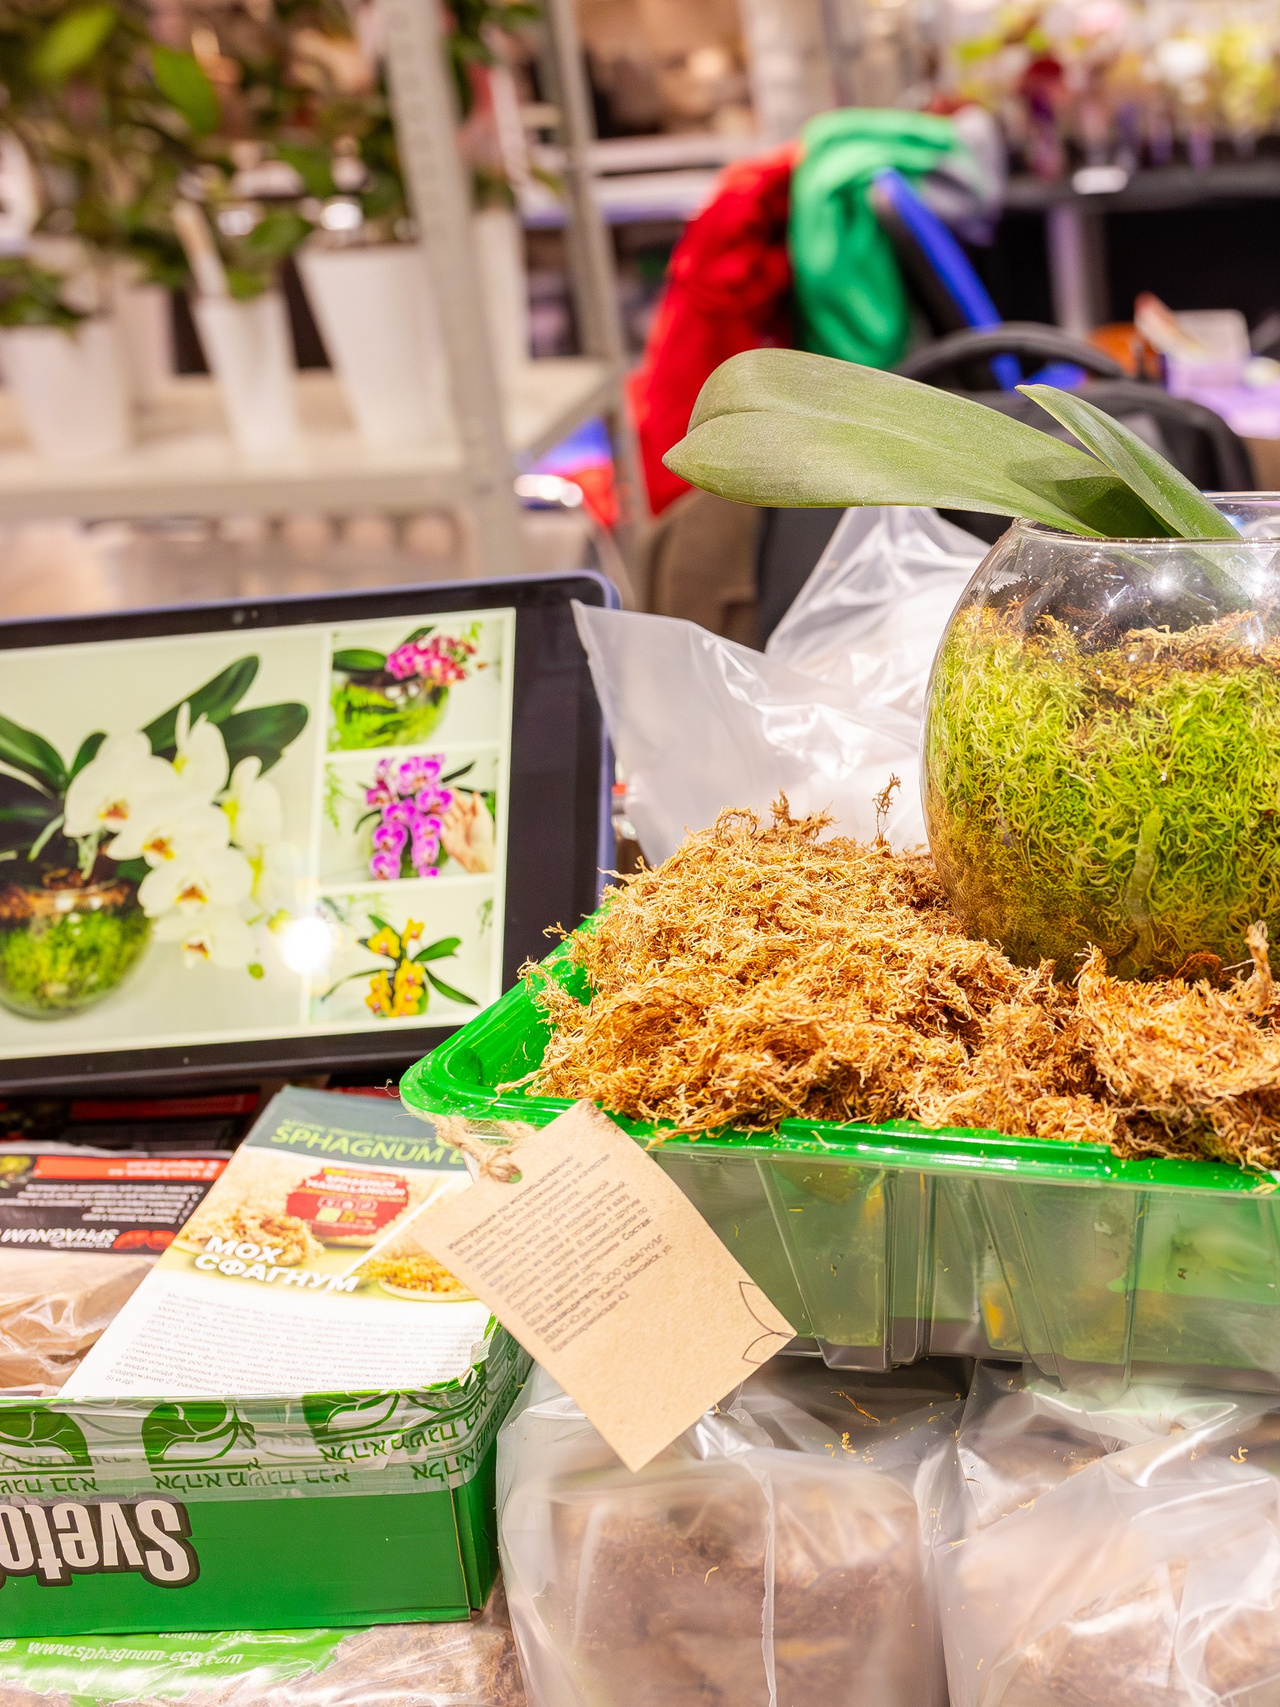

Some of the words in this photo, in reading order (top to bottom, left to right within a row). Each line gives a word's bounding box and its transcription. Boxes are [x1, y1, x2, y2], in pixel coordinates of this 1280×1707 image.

[270, 1126, 444, 1164] SPHAGNUM
[204, 1236, 285, 1265] МОХ
[194, 1253, 361, 1293] СФАГНУМ
[599, 1266, 623, 1285] ООО
[390, 1421, 459, 1451] משגח
[52, 1475, 100, 1493] בנא
[0, 1500, 190, 1582] Sveto
[27, 1641, 245, 1665] www.sphagnum-eco.com
